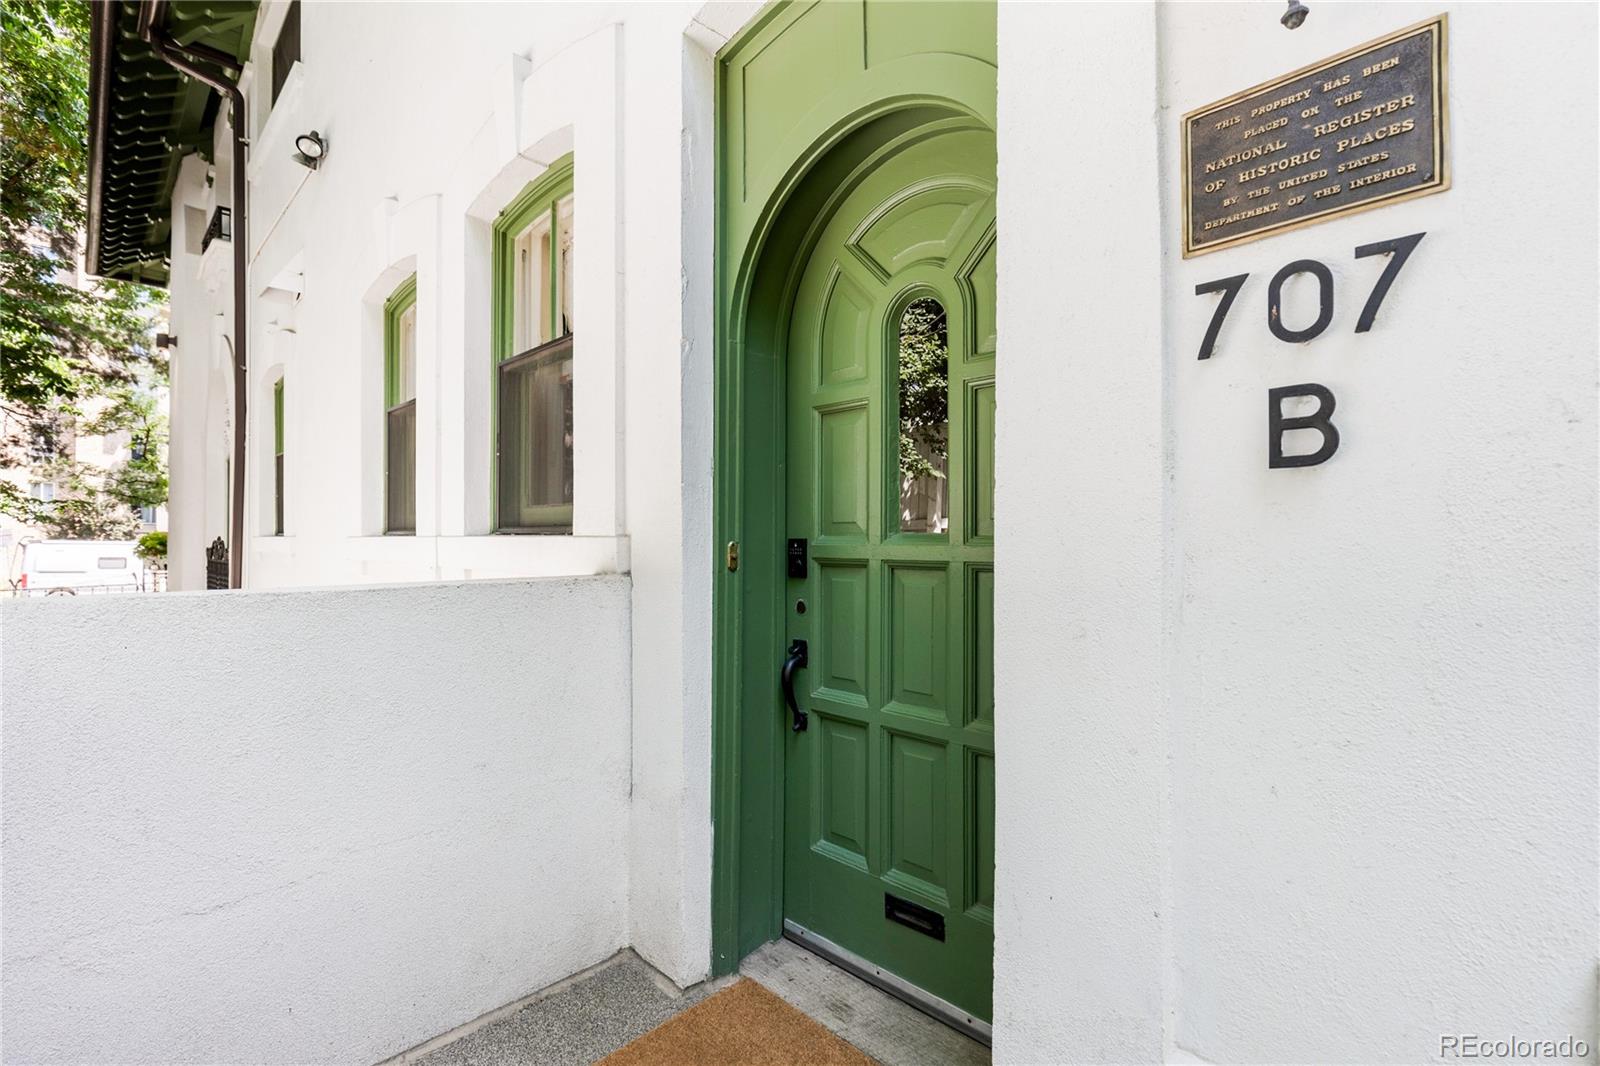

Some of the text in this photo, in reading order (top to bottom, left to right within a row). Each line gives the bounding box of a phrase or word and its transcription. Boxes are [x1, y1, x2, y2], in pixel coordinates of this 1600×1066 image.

[1214, 56, 1400, 130] THIS PROPERTY HAS BEEN
[1243, 90, 1362, 139] PLACED ON THE
[1204, 94, 1415, 173] NATIONAL REGISTER
[1204, 118, 1415, 194] OF HISTORIC PLACES
[1204, 163, 1417, 230] DEPARTMENT OF THE INTERIOR
[1223, 151, 1389, 208] BY THE UNITED STATES
[1195, 231, 1427, 361] 707
[1268, 383, 1340, 469] B
